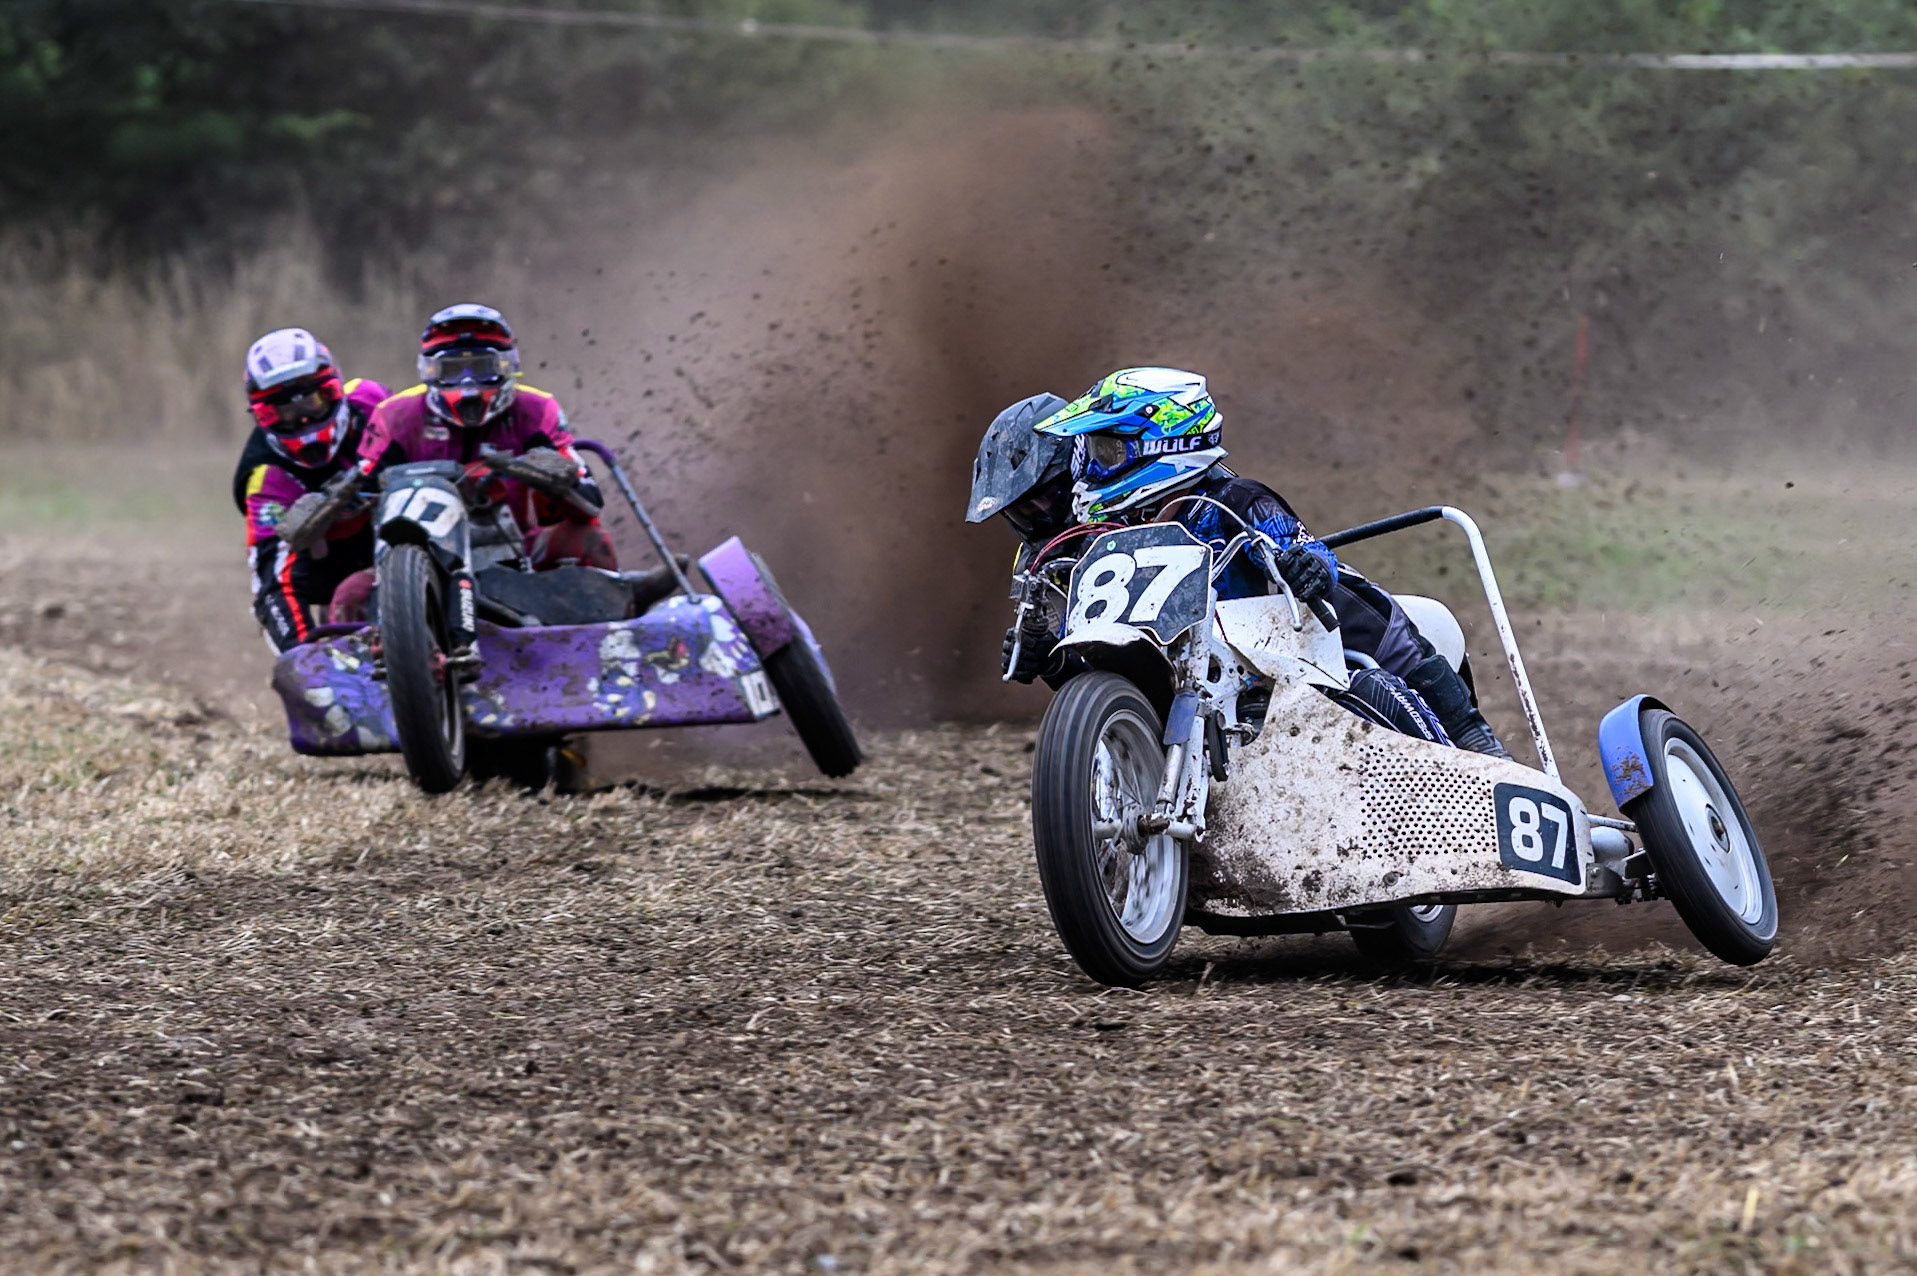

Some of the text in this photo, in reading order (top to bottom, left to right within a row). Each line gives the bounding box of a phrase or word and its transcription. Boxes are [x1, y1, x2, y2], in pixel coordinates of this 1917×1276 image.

[1142, 435, 1202, 456] WULF
[381, 486, 465, 538] 10
[1068, 544, 1207, 634] 87
[1391, 690, 1435, 740] SPEEDWAY
[1508, 796, 1569, 869] 87
